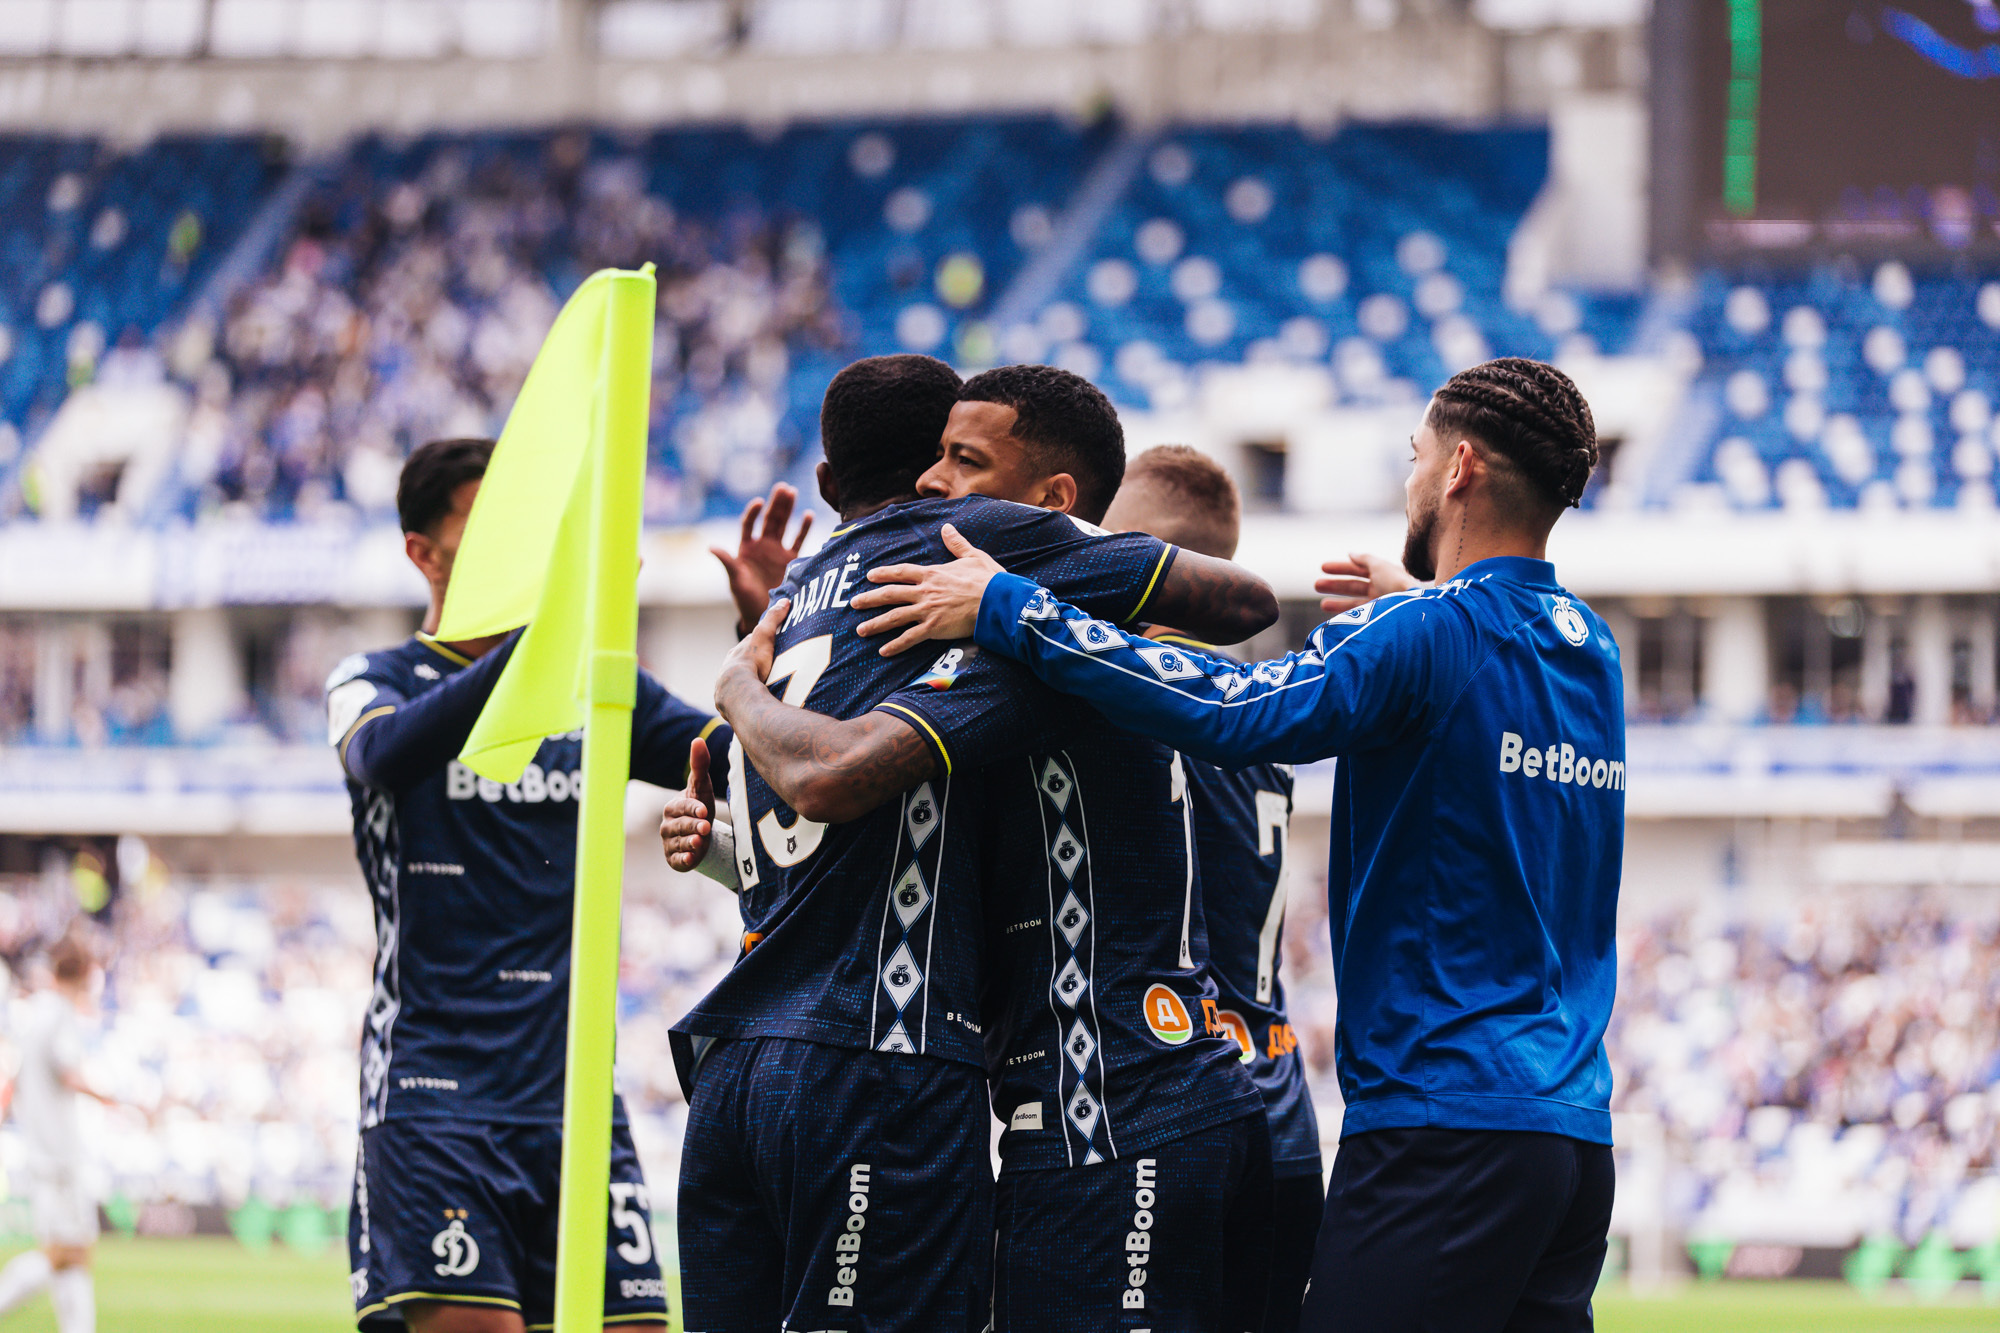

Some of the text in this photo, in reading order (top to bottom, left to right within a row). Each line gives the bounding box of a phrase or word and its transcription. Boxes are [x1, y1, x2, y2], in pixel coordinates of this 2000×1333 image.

[775, 552, 860, 635] МАЛЁ
[1499, 731, 1625, 791] BetBoom
[1156, 997, 1181, 1027] Д
[1006, 1049, 1046, 1066] ETBOOM
[827, 1163, 871, 1307] BetBoom
[1122, 1158, 1157, 1310] BetBoom
